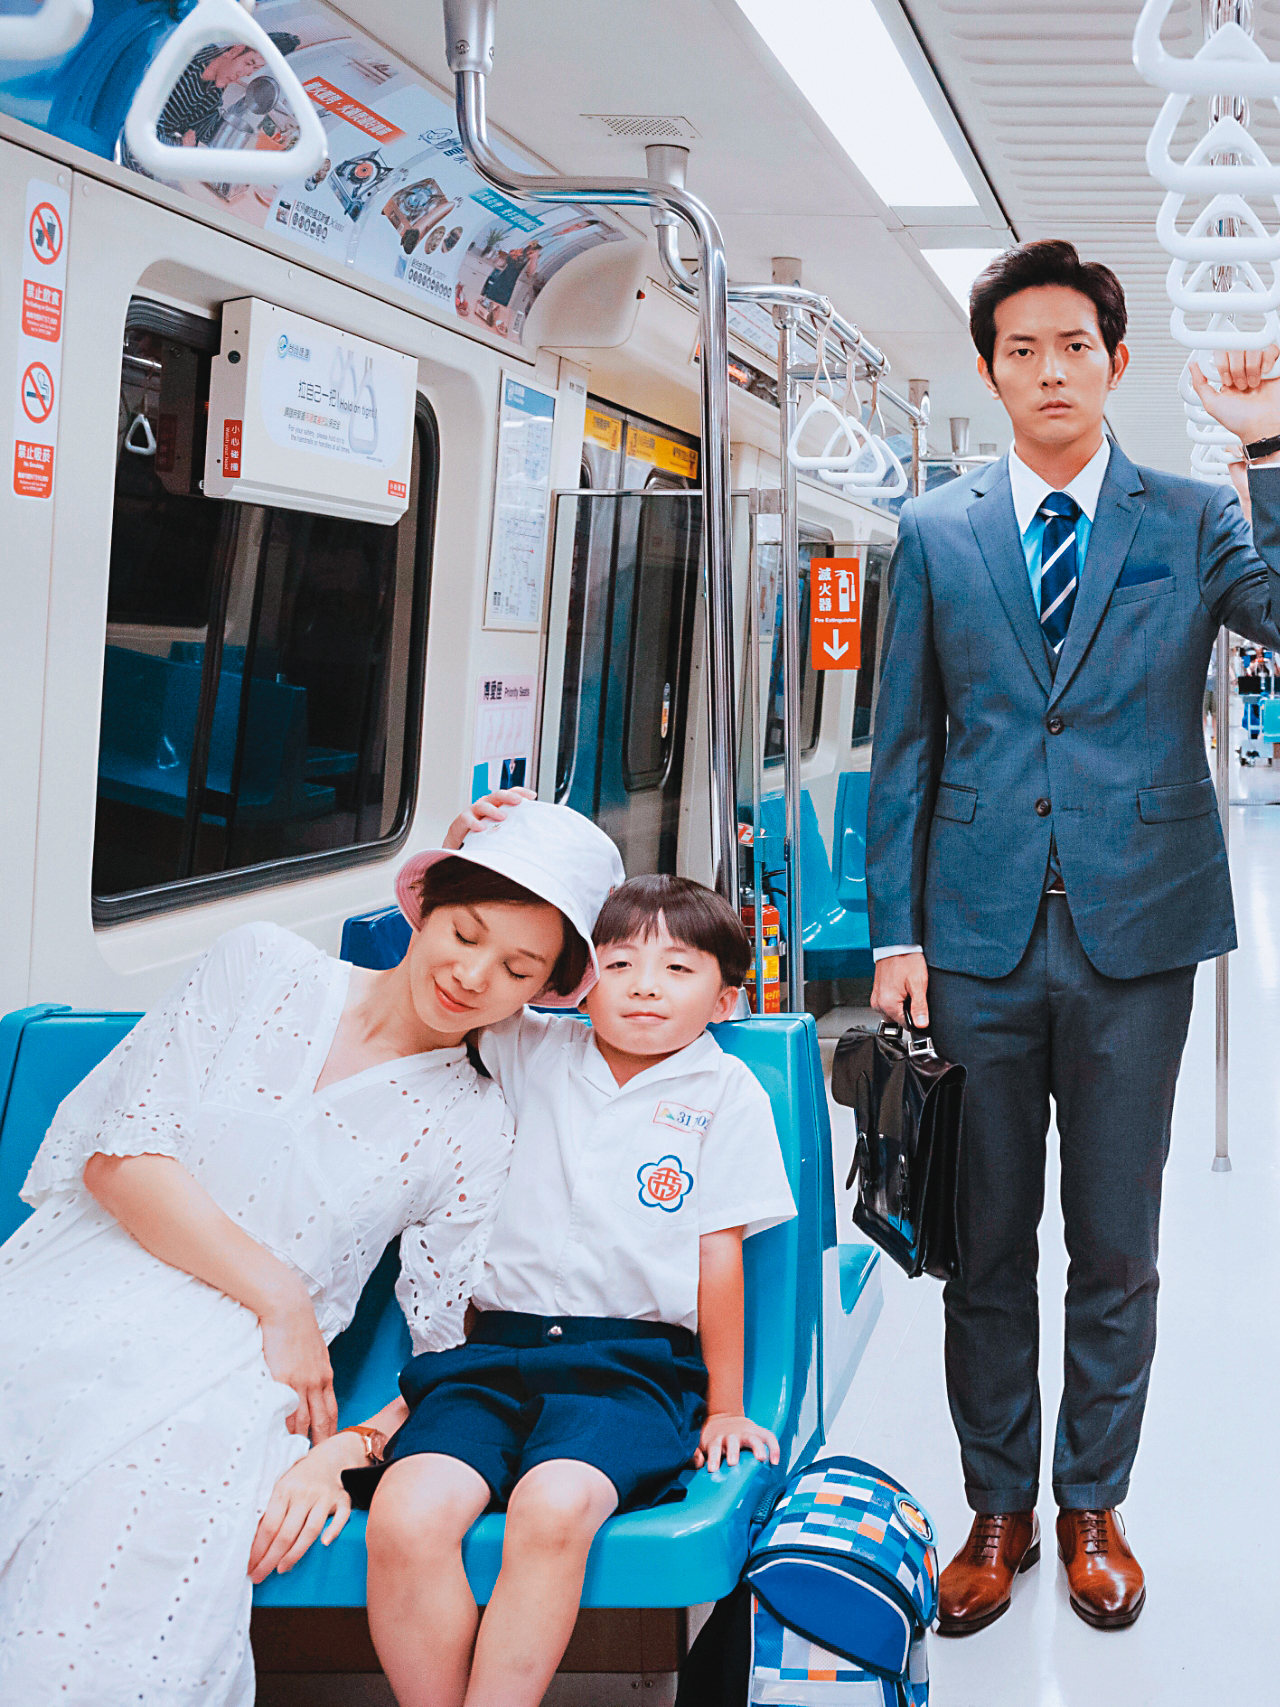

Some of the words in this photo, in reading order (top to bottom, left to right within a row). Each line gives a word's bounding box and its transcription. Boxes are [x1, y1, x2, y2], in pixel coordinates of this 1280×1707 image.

[26, 283, 60, 306] 禁止飲食
[340, 399, 353, 412] Hold
[353, 404, 361, 413] on
[18, 444, 51, 463] 禁止吸菸
[29, 462, 44, 470] Smoking
[818, 567, 832, 612] 滅火器
[484, 680, 503, 700] 博愛座
